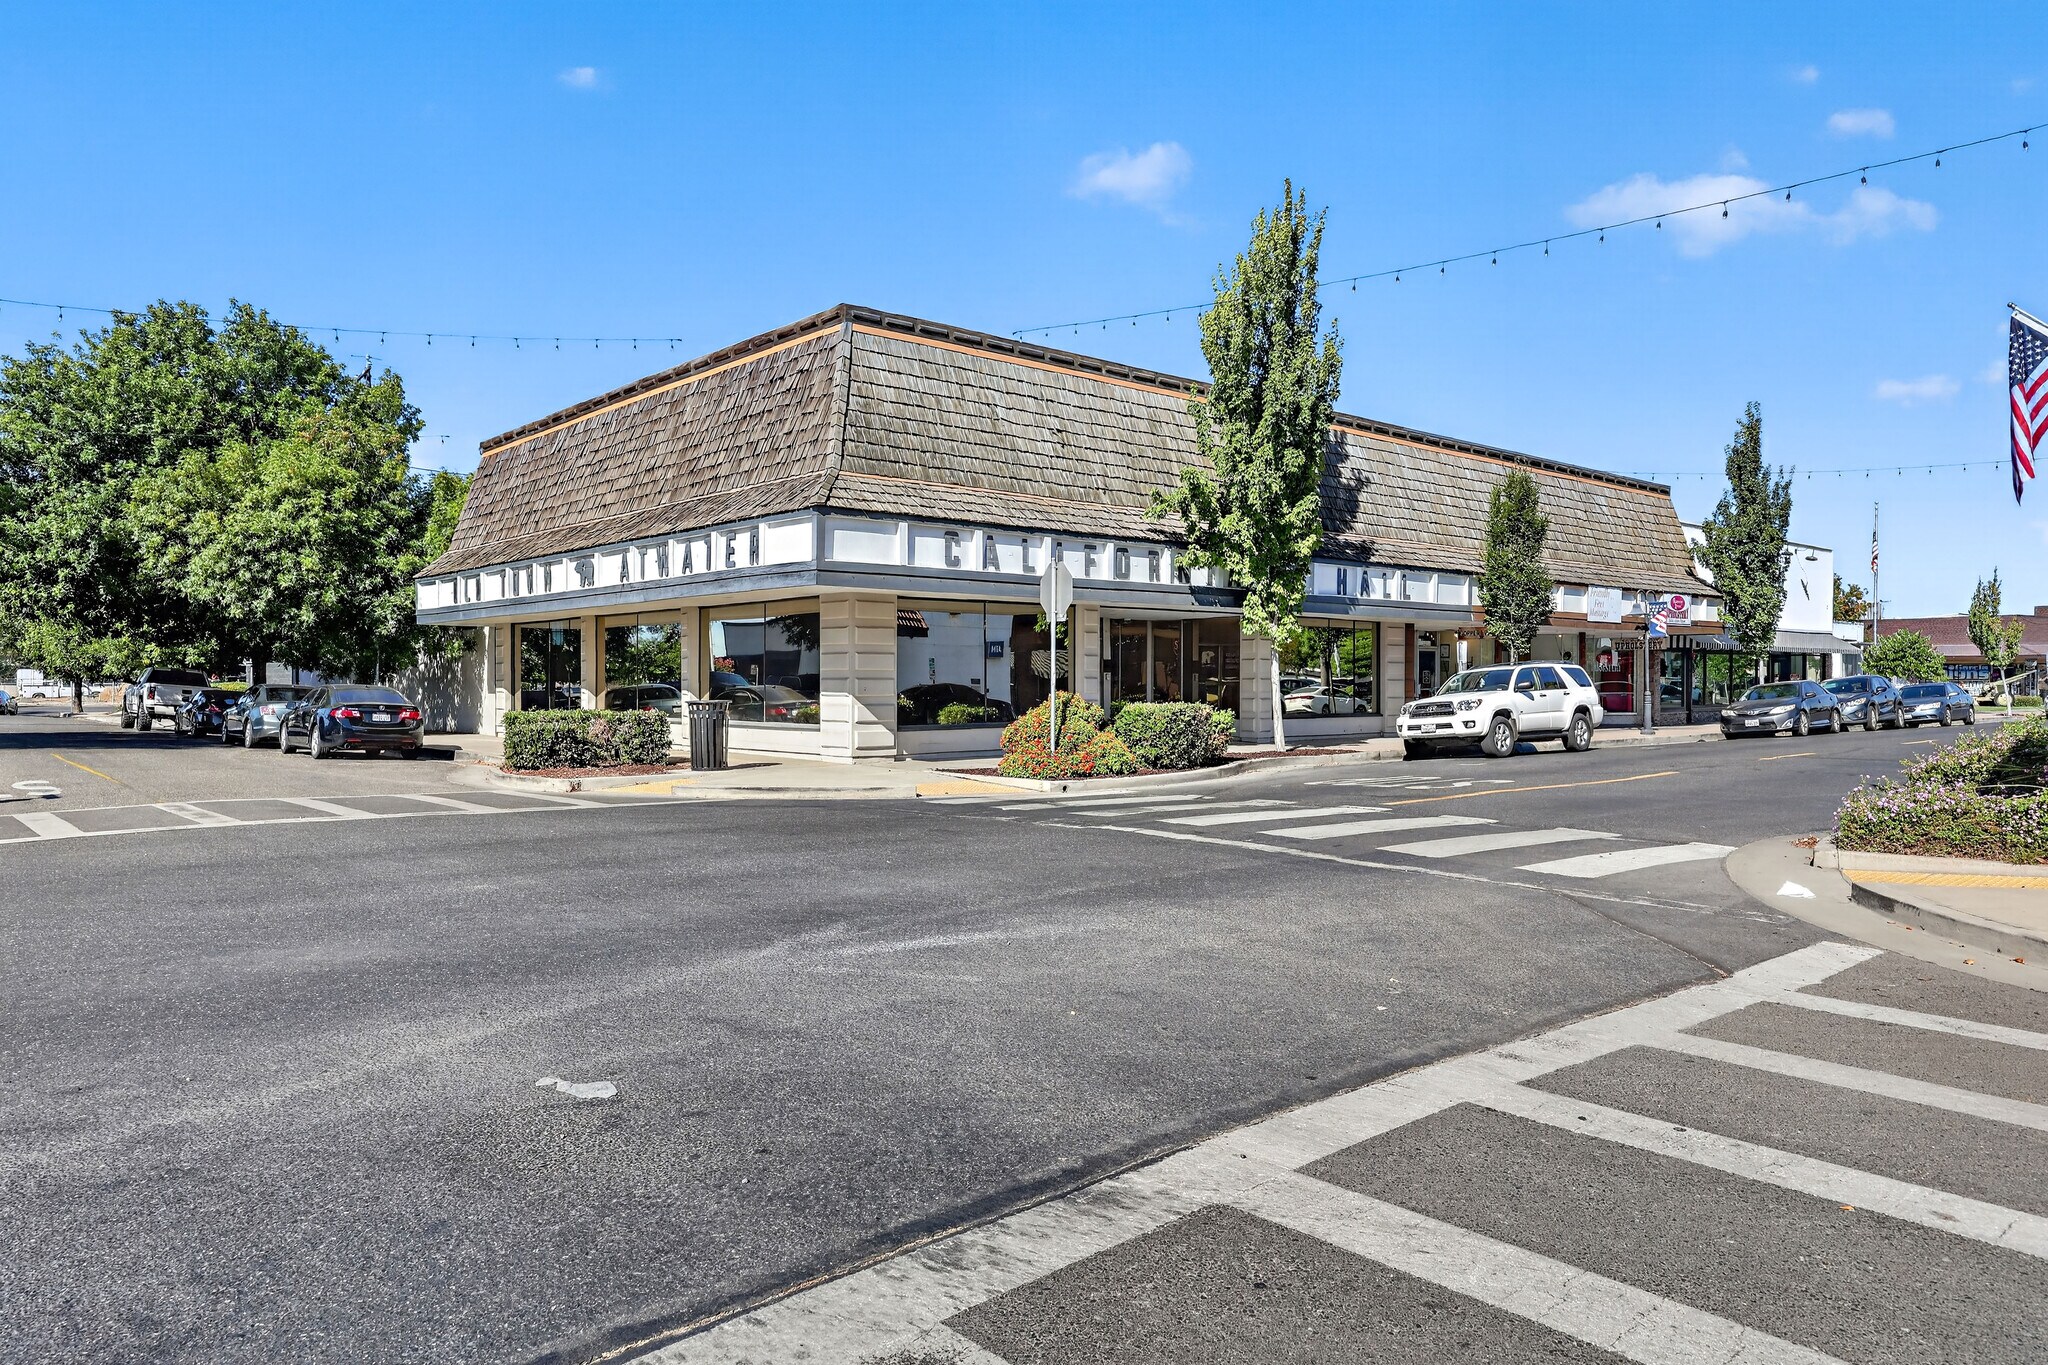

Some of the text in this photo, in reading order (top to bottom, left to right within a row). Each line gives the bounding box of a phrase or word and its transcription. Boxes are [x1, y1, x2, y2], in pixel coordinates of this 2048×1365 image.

[619, 529, 759, 583] ATWATER
[1336, 567, 1411, 600] HALL
[1615, 640, 1663, 650] UPHOLSERY
